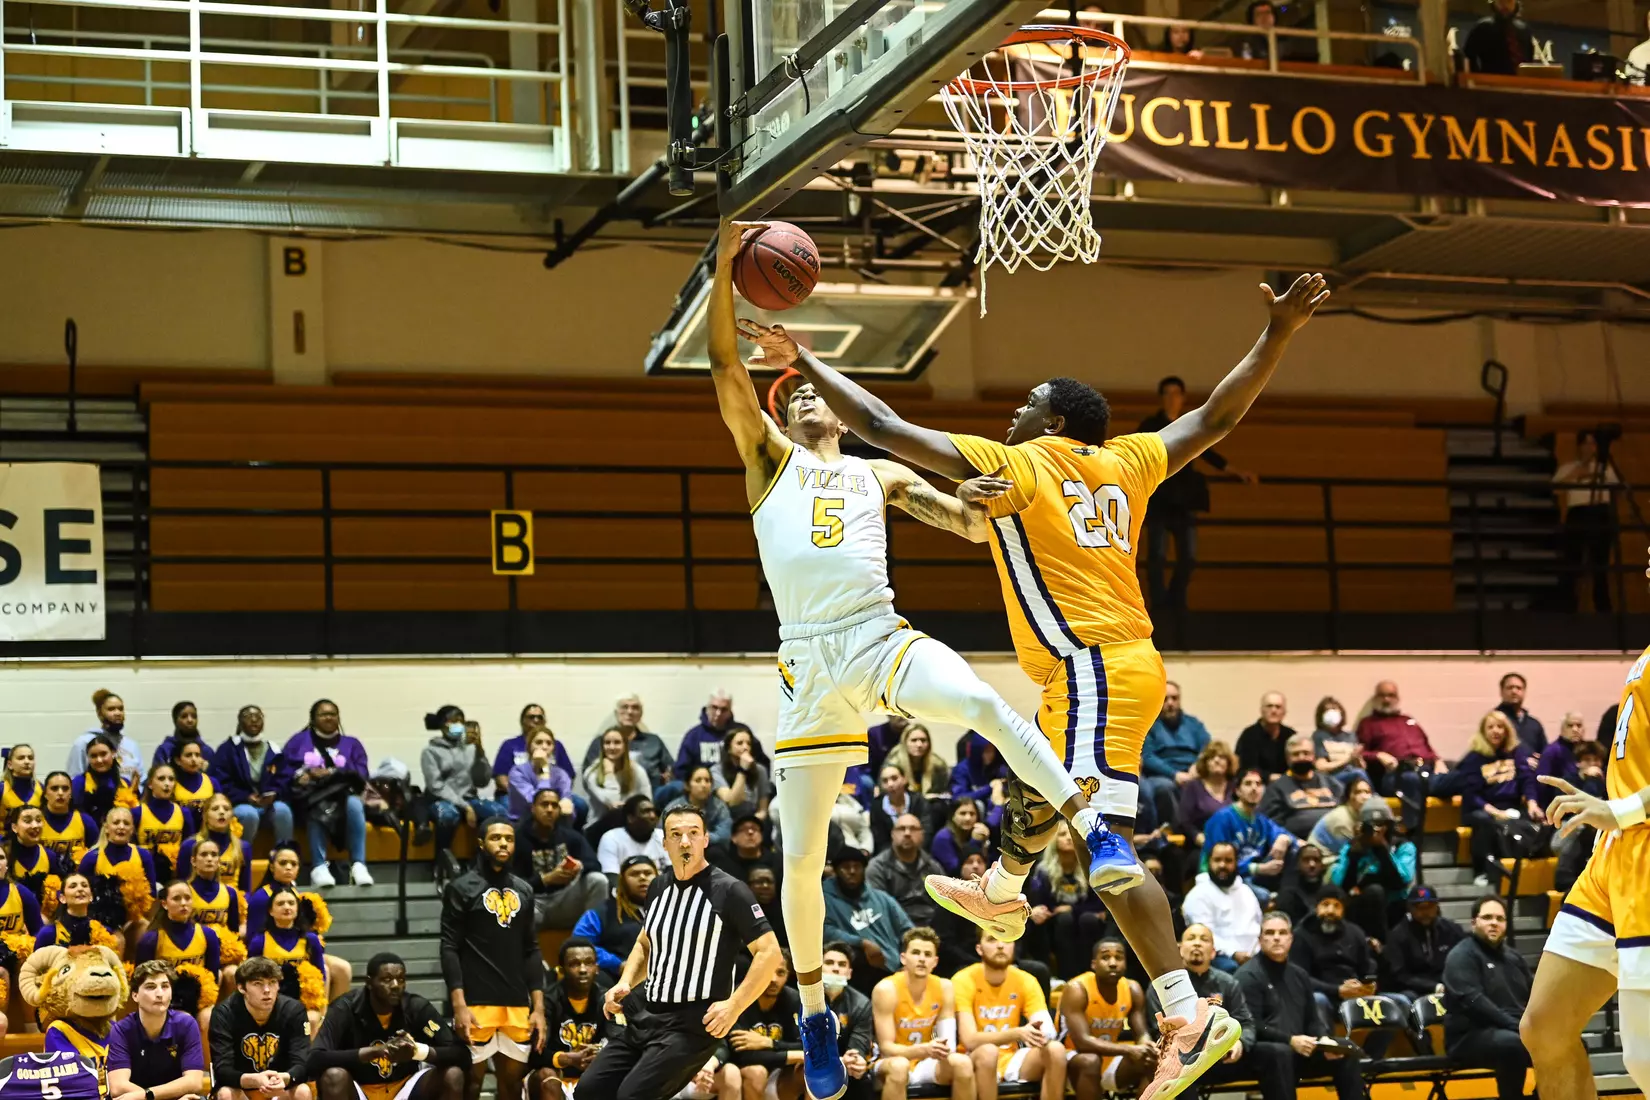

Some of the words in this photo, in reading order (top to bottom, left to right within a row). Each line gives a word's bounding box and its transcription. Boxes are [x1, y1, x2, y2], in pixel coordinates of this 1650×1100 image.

[283, 246, 307, 276] B
[772, 259, 811, 299] Wilson
[796, 465, 868, 496] VILLE
[811, 496, 845, 548] 5
[1061, 480, 1132, 555] 20
[494, 513, 531, 571] B
[2, 602, 98, 615] COMPANY
[16, 1066, 53, 1080] GOLDEN
[40, 1077, 63, 1100] 5
